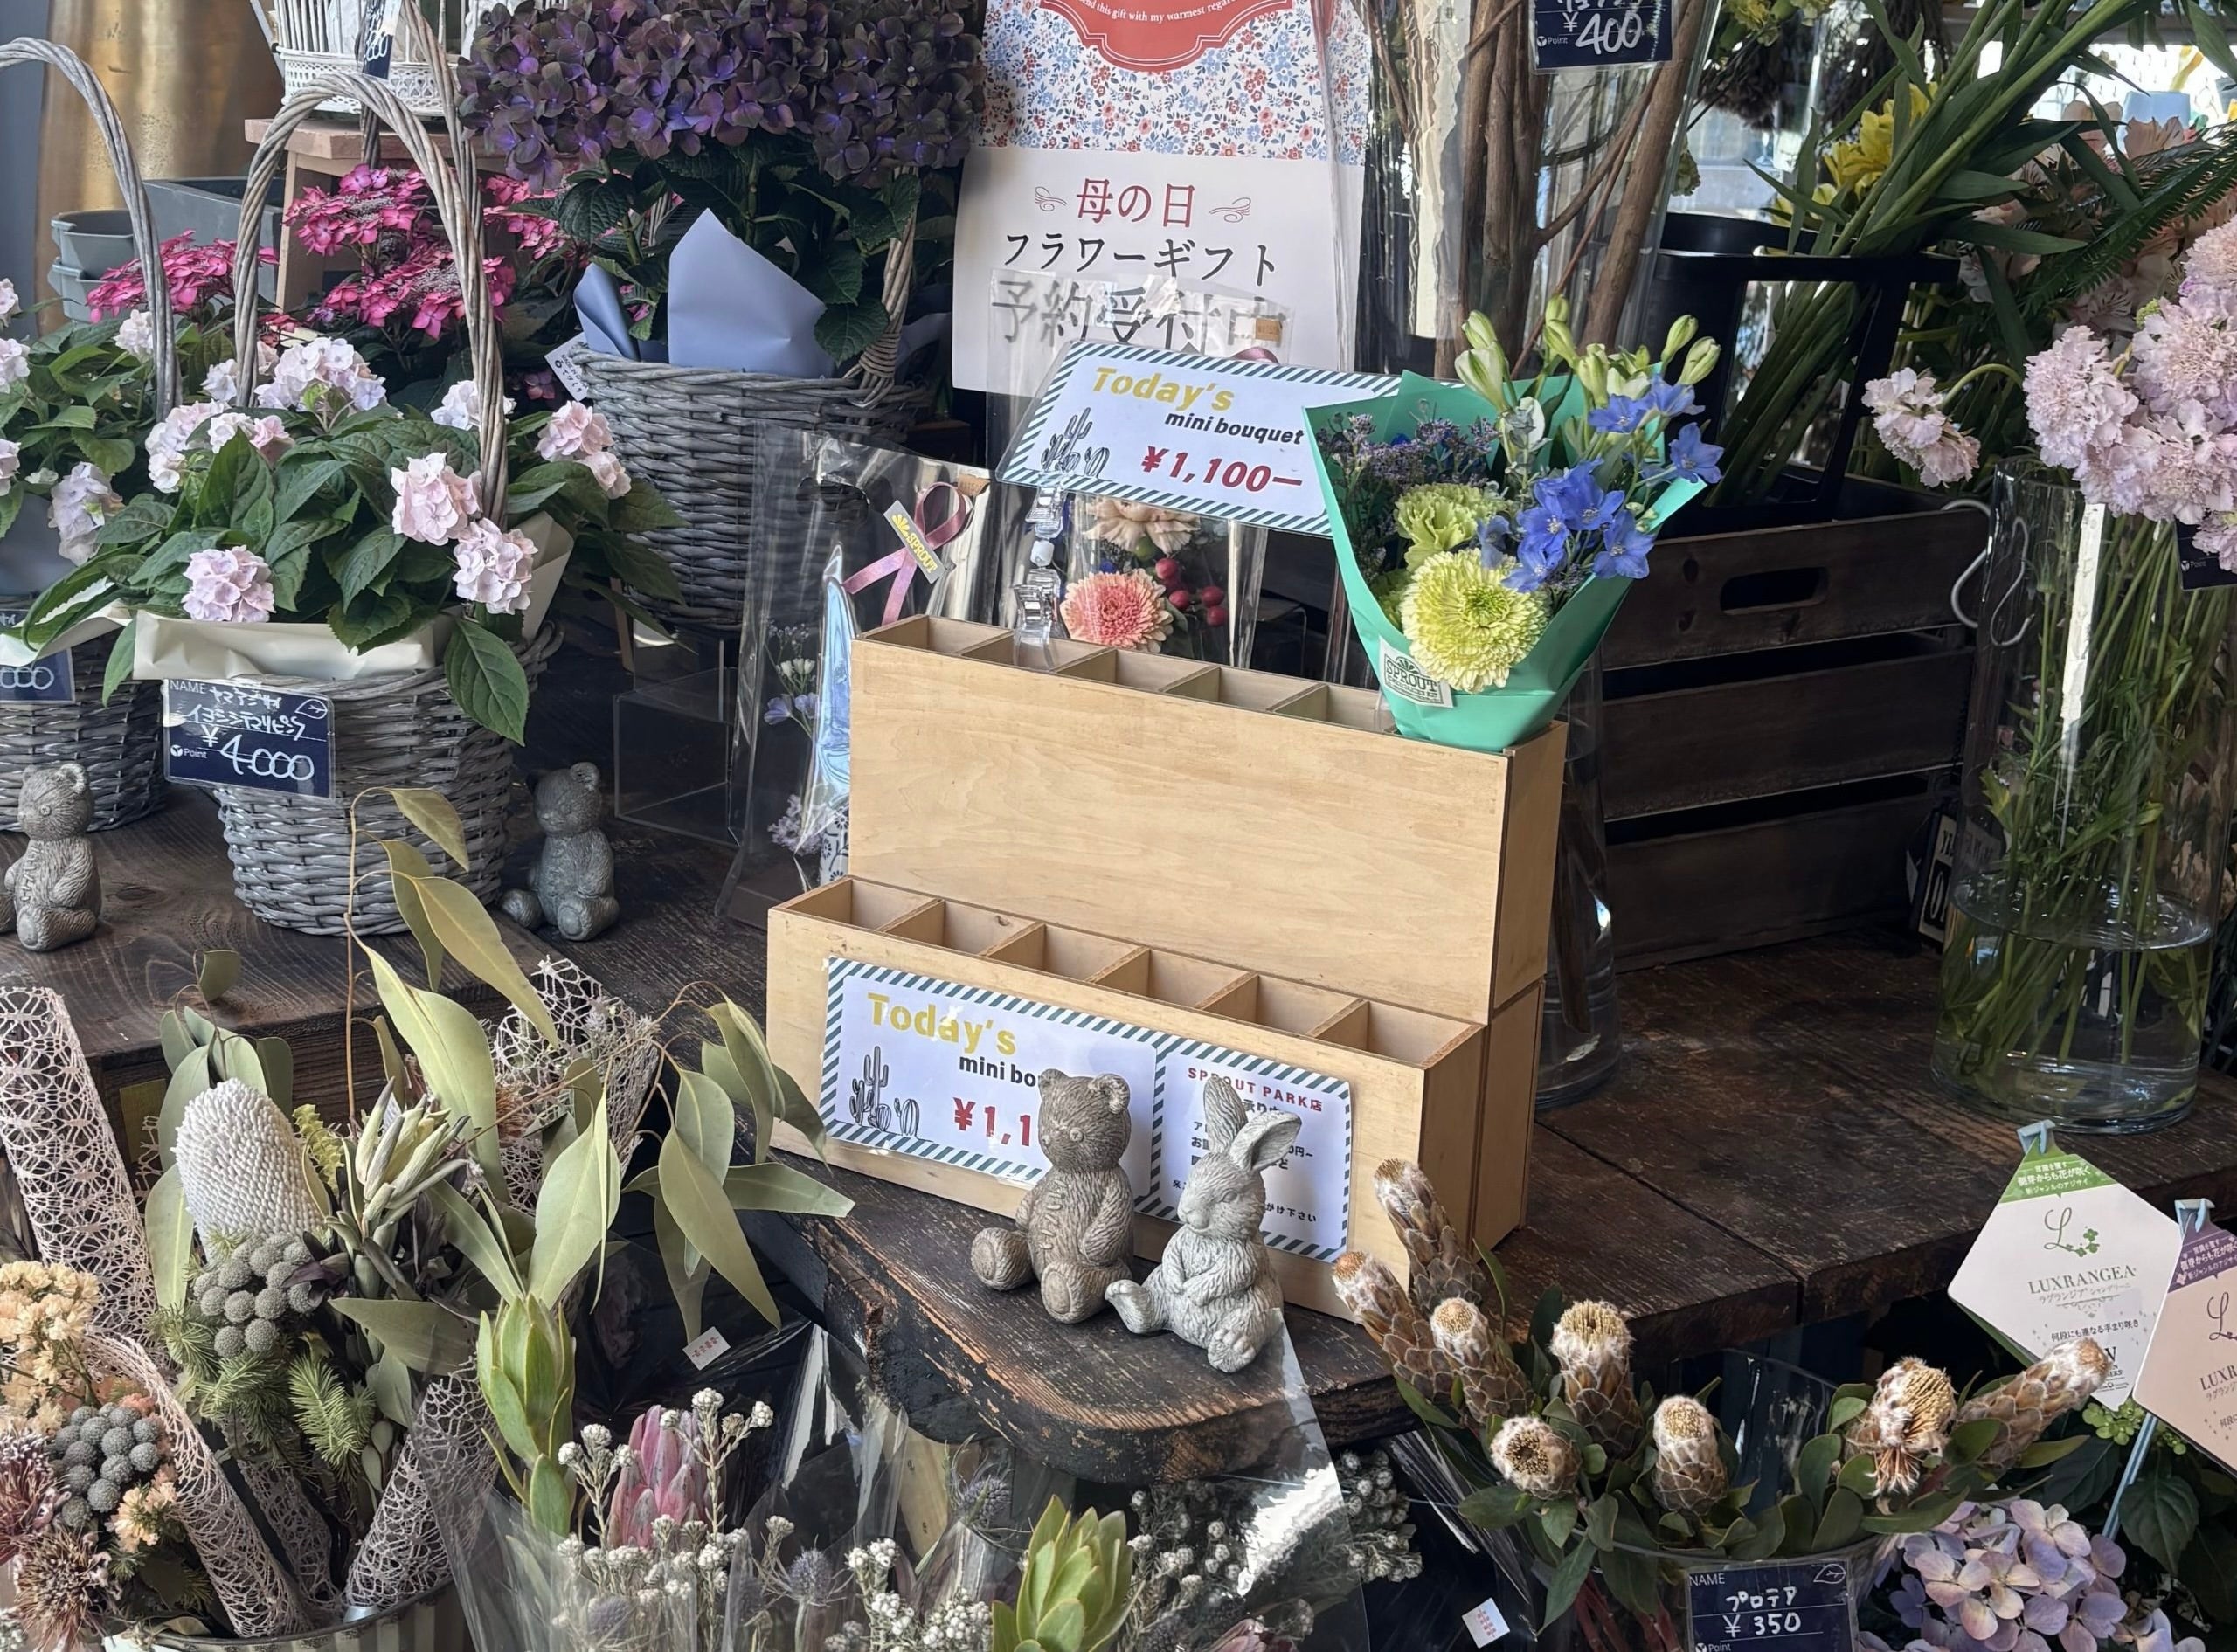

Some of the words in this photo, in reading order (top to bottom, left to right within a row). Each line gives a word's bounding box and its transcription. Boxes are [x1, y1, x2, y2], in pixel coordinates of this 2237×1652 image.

[1097, 3, 1112, 15] this
[1112, 8, 1126, 19] gift
[1127, 12, 1148, 22] with
[1150, 13, 1166, 24] my
[1167, 8, 1206, 22] warmest
[1575, 10, 1643, 54] 400
[1077, 178, 1195, 227] 母の日
[1005, 232, 1276, 287] フラワーギフト
[1092, 367, 1235, 411] Today's
[1164, 411, 1215, 433] mini
[1219, 417, 1304, 446] bouquet
[906, 532, 938, 574] SPROUT
[170, 681, 206, 695] NAME
[1386, 660, 1438, 693] SPROUT
[184, 748, 207, 759] Point
[219, 734, 315, 781] 4000
[868, 992, 1017, 1055] Today's
[959, 1056, 1004, 1080] mini
[1010, 1064, 1037, 1087] bo
[2027, 1264, 2136, 1295] LUXRANGEA
[1688, 1573, 1726, 1586] NAME
[1725, 1586, 1798, 1613] プロテア
[1753, 1611, 1802, 1636] 350
[1708, 1642, 1732, 1652] Point
